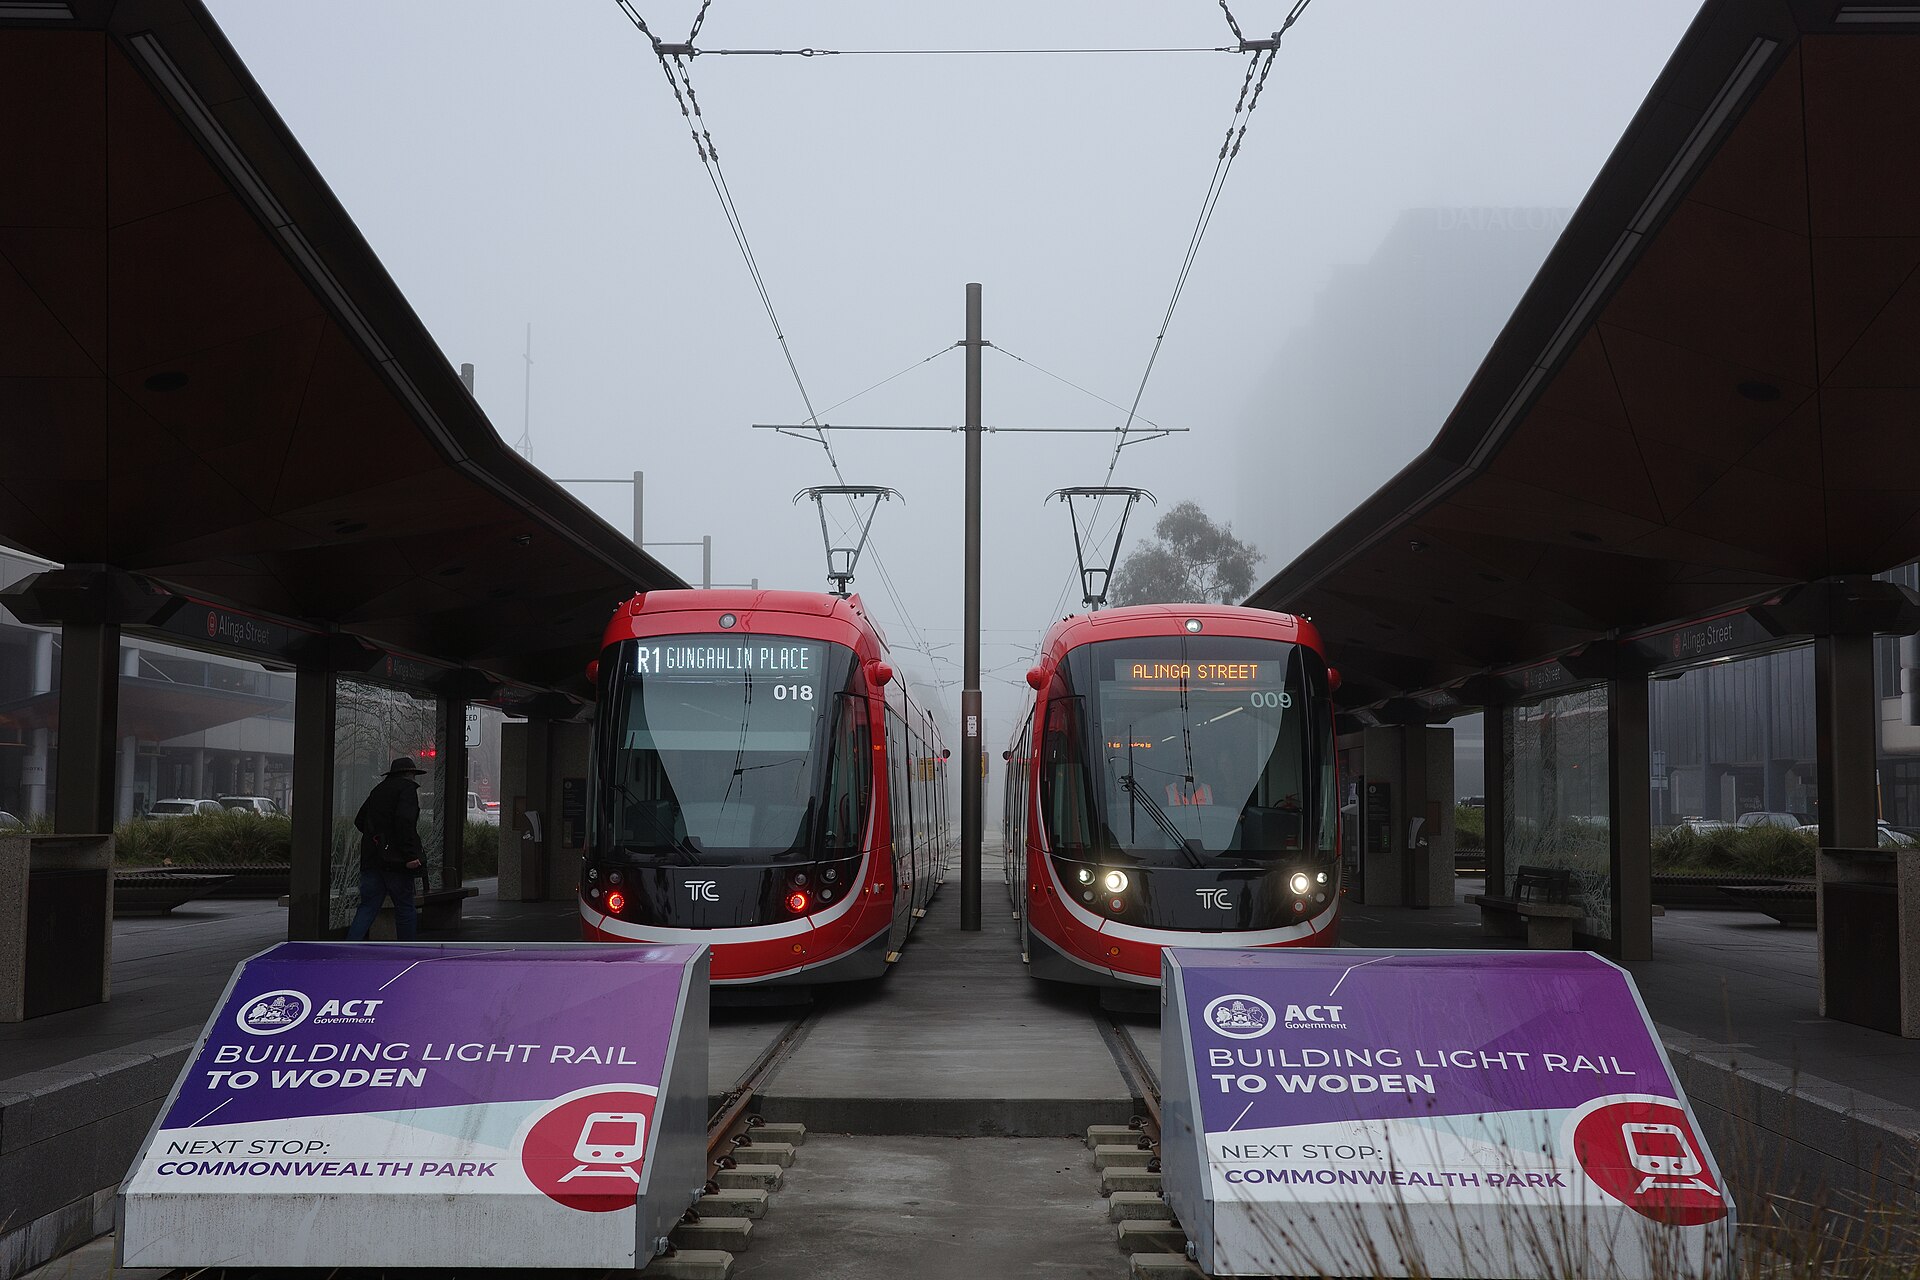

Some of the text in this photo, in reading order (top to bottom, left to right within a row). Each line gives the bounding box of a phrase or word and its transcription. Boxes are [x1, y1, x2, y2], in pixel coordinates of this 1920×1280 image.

[218, 615, 271, 645] Alinga Street
[1682, 622, 1733, 654] Alinga Street
[637, 647, 809, 673] R1 GUNGAHLIN PLACE
[1133, 664, 1258, 679] ALINGA STREET
[773, 684, 813, 701] 018
[1250, 692, 1292, 709] 009
[684, 881, 720, 902] TC
[1195, 888, 1233, 910] TC
[316, 999, 384, 1017] ACT
[1284, 1004, 1343, 1022] ACT
[313, 1016, 376, 1025] Government
[1284, 1021, 1347, 1030] Government
[213, 1042, 637, 1065] BUILDING LIGHT RAIL
[1208, 1048, 1636, 1076] BUILDING LIGHT RAIL
[206, 1068, 427, 1090] TO WODEN
[1211, 1074, 1436, 1094] TO WODEN
[166, 1139, 331, 1155] NEXT STOP:
[1221, 1143, 1384, 1161] NEXT STOP:
[156, 1161, 499, 1177] COMMONWEALTH PARK
[1224, 1169, 1567, 1189] COMMONWEALTH PARK
